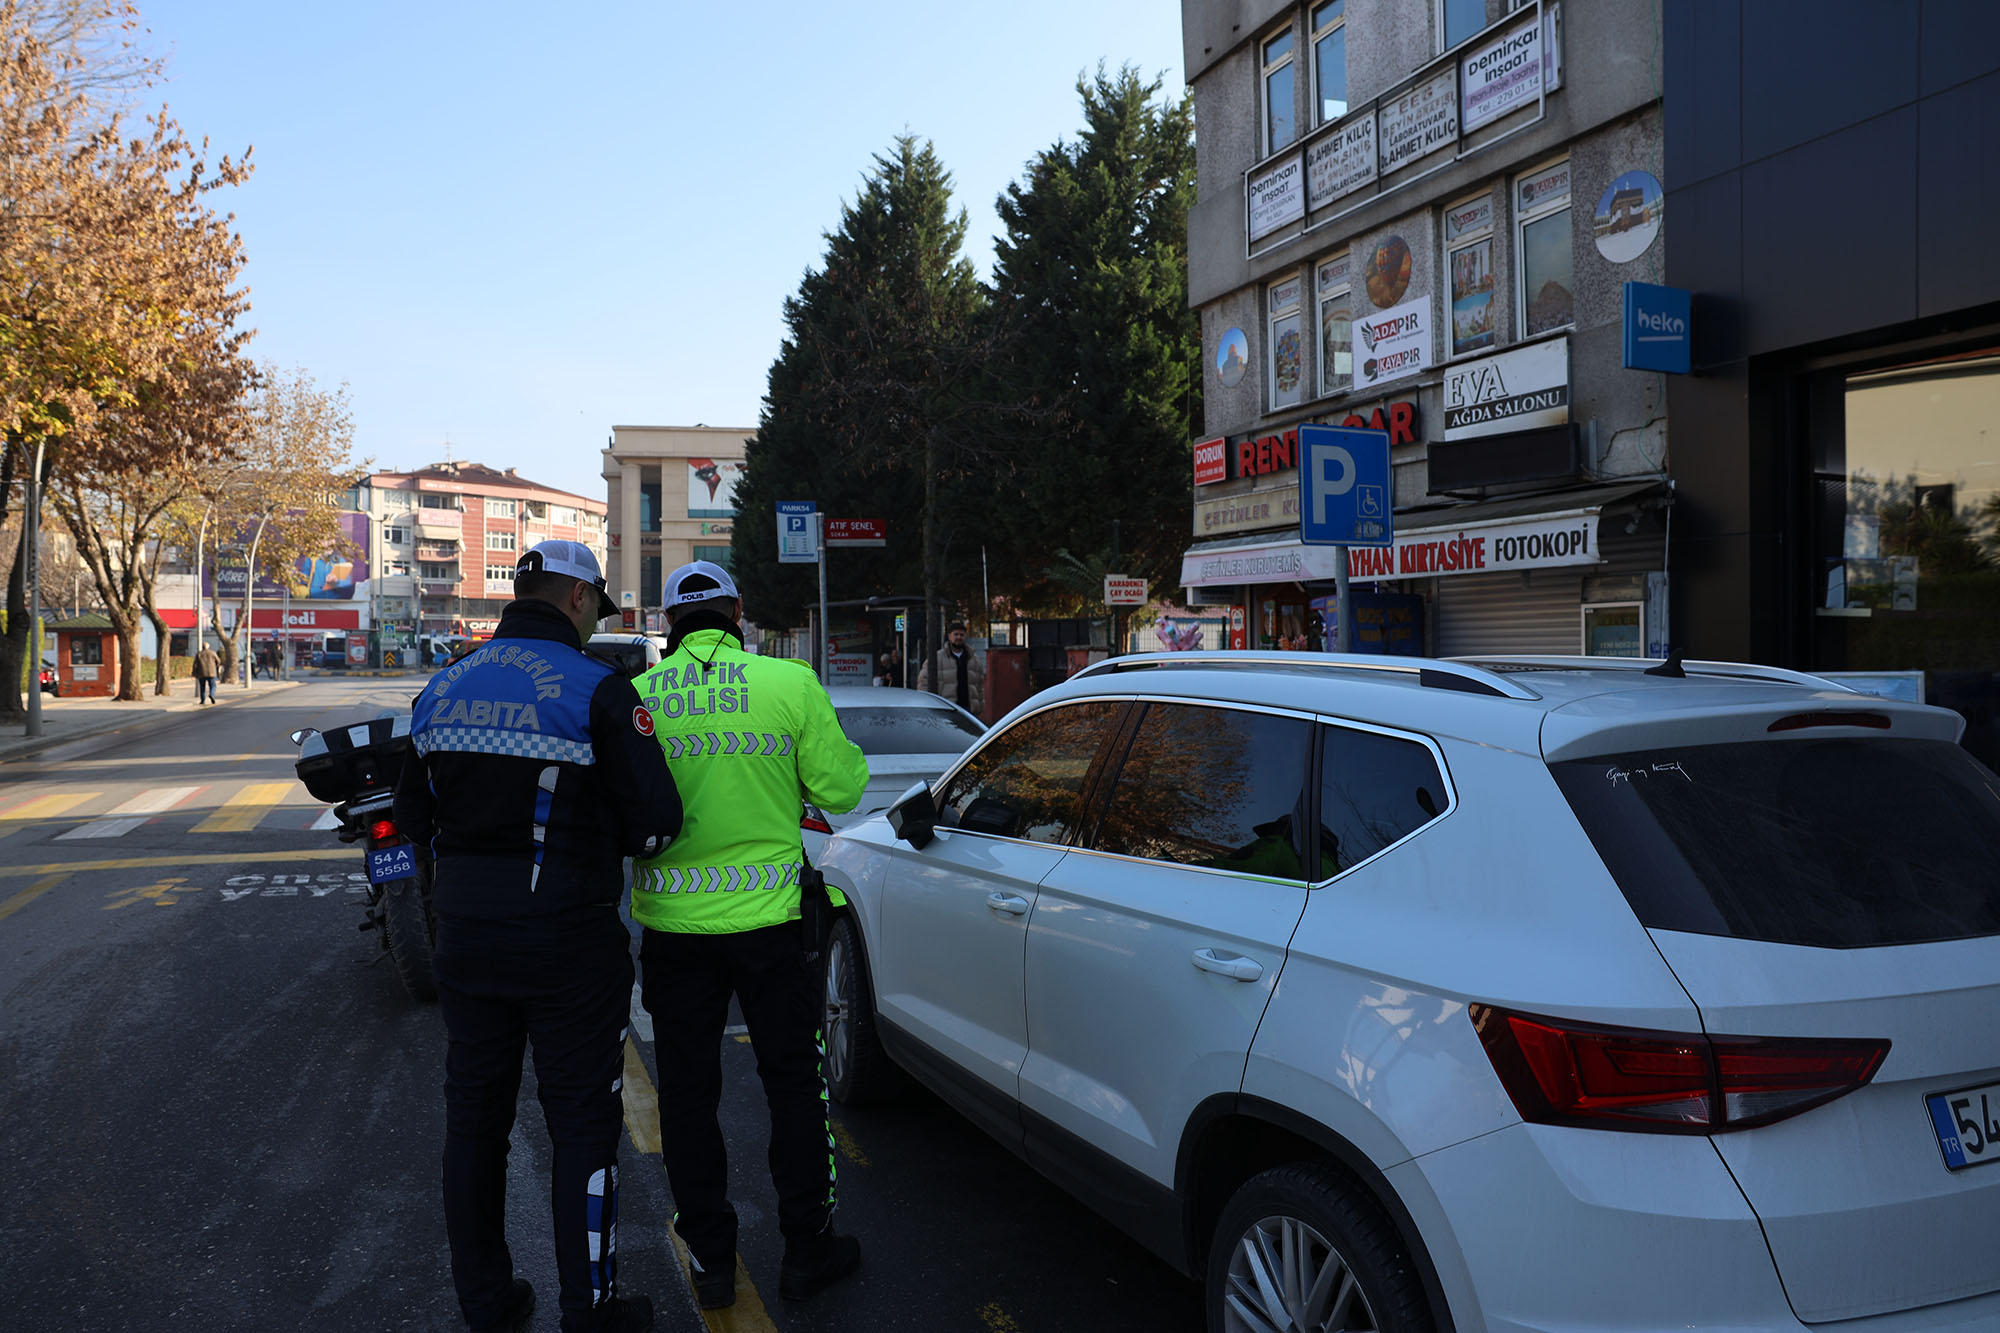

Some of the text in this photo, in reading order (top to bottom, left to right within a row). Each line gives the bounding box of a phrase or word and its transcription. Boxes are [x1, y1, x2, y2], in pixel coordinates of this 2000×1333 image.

[1515, 83, 1525, 95] 01
[1346, 120, 1371, 147] KILIÇ
[1425, 118, 1456, 147] KILIÇ
[1446, 363, 1509, 411] EVA
[1451, 390, 1561, 428] AĞDA SALONU
[1196, 444, 1224, 465] DORUK
[1311, 444, 1357, 525] P
[1399, 532, 1486, 574] KIRTASİYE
[1495, 522, 1589, 562] FOTOKOPİ
[431, 699, 541, 731] ZABITA
[374, 850, 408, 865] 54 A
[376, 862, 410, 877] 5558
[1942, 1136, 1960, 1154] TR
